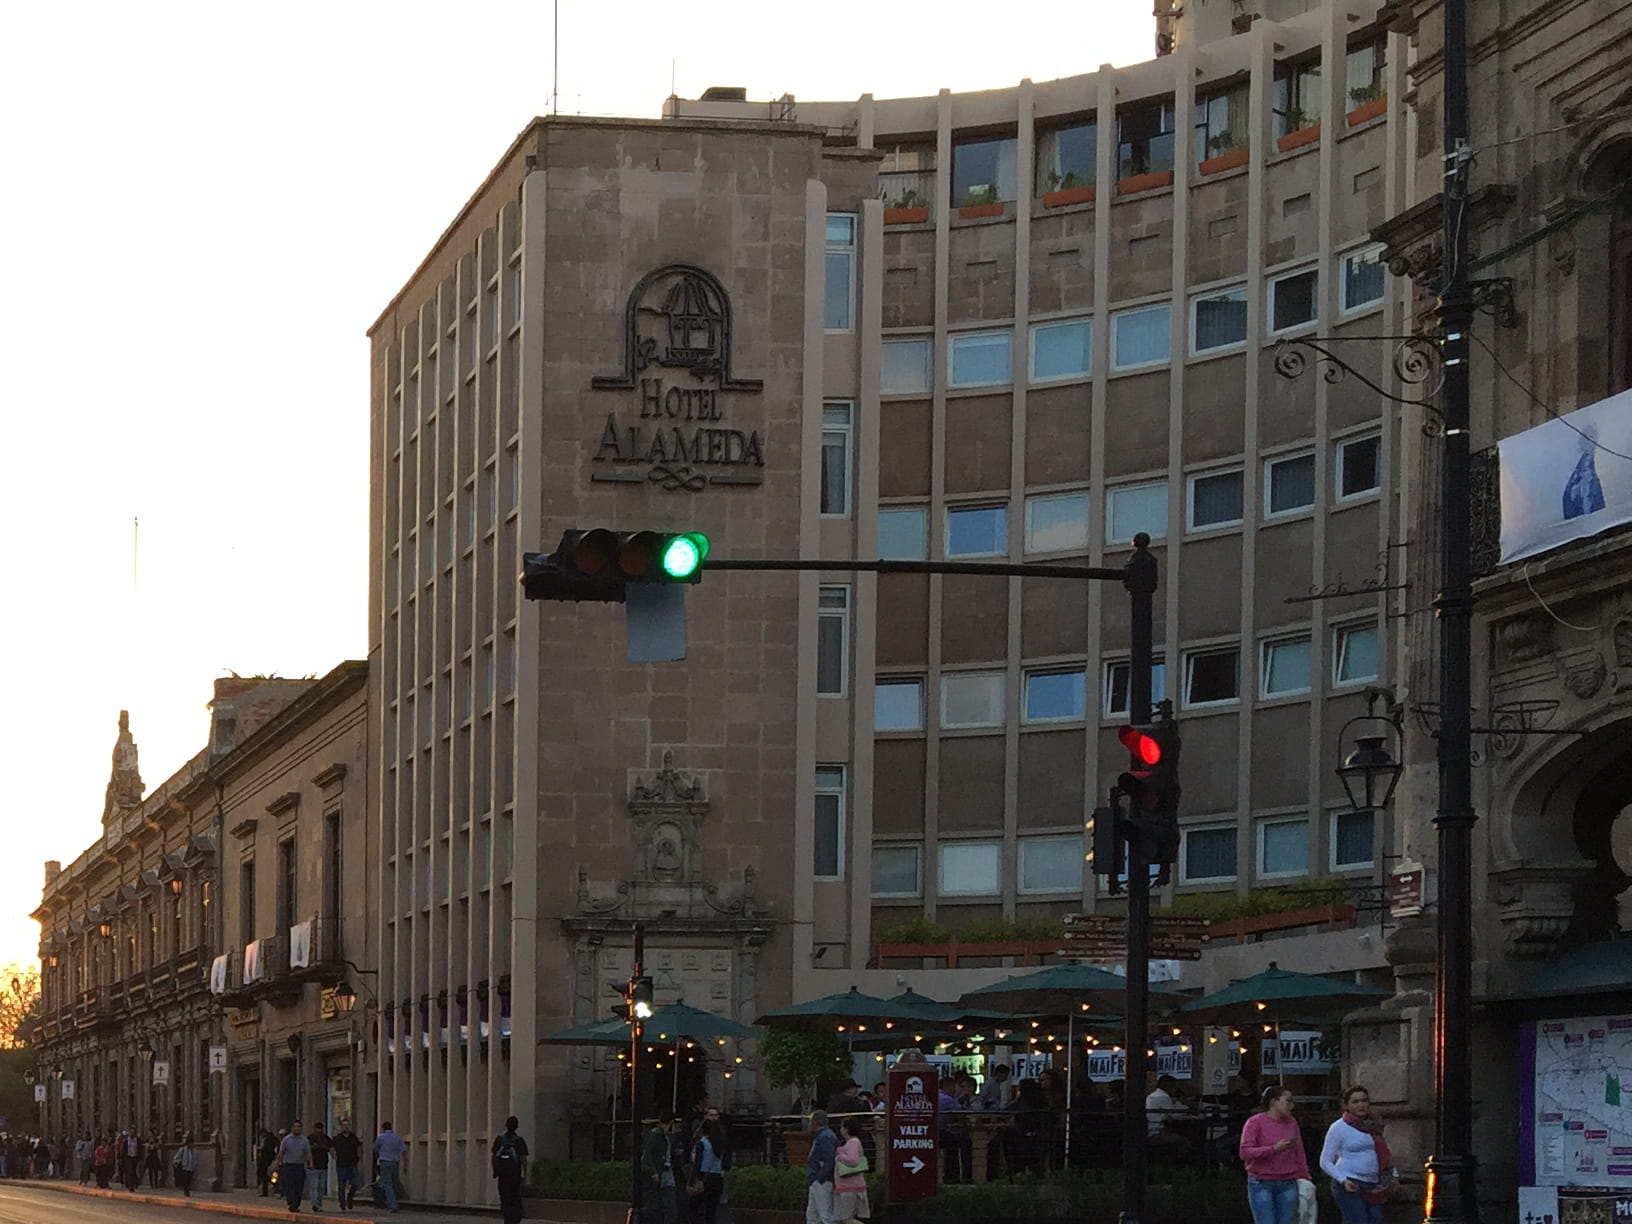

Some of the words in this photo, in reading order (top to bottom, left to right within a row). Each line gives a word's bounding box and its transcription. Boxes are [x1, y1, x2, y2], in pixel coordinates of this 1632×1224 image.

[640, 378, 723, 421] HOTEL
[592, 409, 765, 467] ALAMEDA
[894, 1101, 934, 1111] ALAMEDA
[899, 1125, 929, 1136] VALET
[893, 1138, 934, 1150] PARKING
